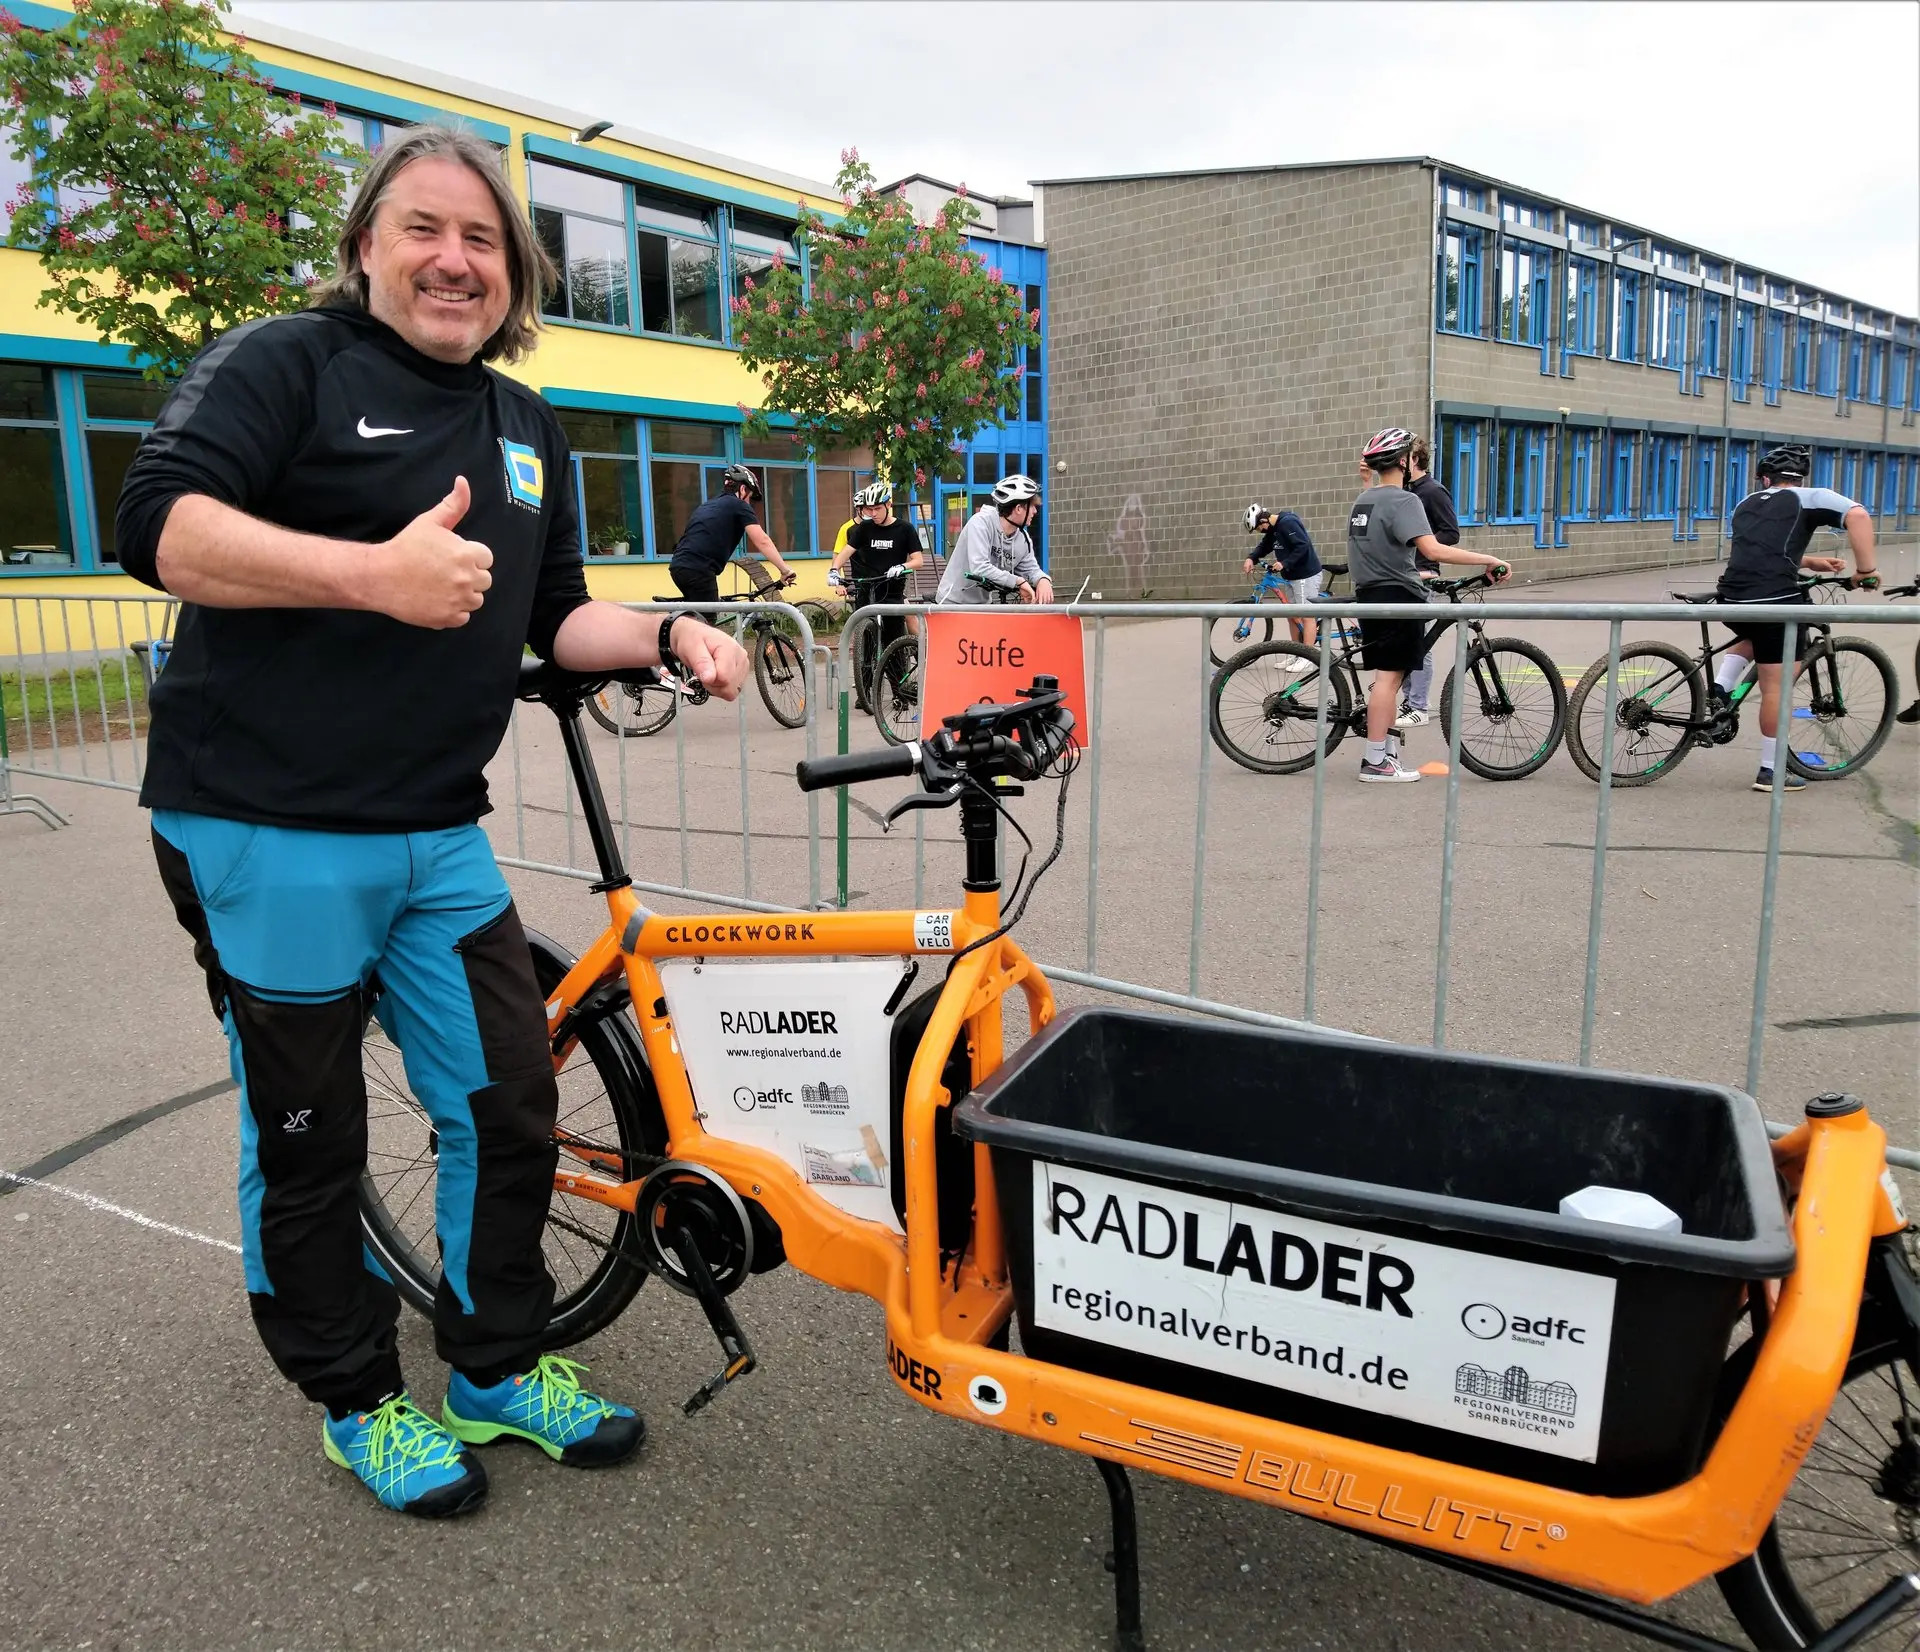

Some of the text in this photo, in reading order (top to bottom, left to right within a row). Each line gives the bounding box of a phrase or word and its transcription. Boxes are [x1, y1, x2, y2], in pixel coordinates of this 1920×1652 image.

[957, 638, 1025, 668] Stufe
[926, 915, 949, 924] CAR
[665, 923, 815, 943] CLOCKWORK
[933, 926, 949, 936] GO
[917, 937, 950, 947] VELO
[720, 1011, 838, 1034] RADLADER
[726, 1047, 842, 1059] www.regionalverband.de
[757, 1088, 793, 1103] adfc
[811, 1172, 850, 1183] SAARLAND
[1051, 1181, 1415, 1318] RADLADER
[1051, 1281, 1410, 1391] regionalverband.de
[1511, 1316, 1586, 1344] adfc
[1511, 1334, 1545, 1346] Saarland
[1454, 1395, 1575, 1429] REGIONALVERBAND
[1467, 1410, 1559, 1437] SAARBRÜCKEN
